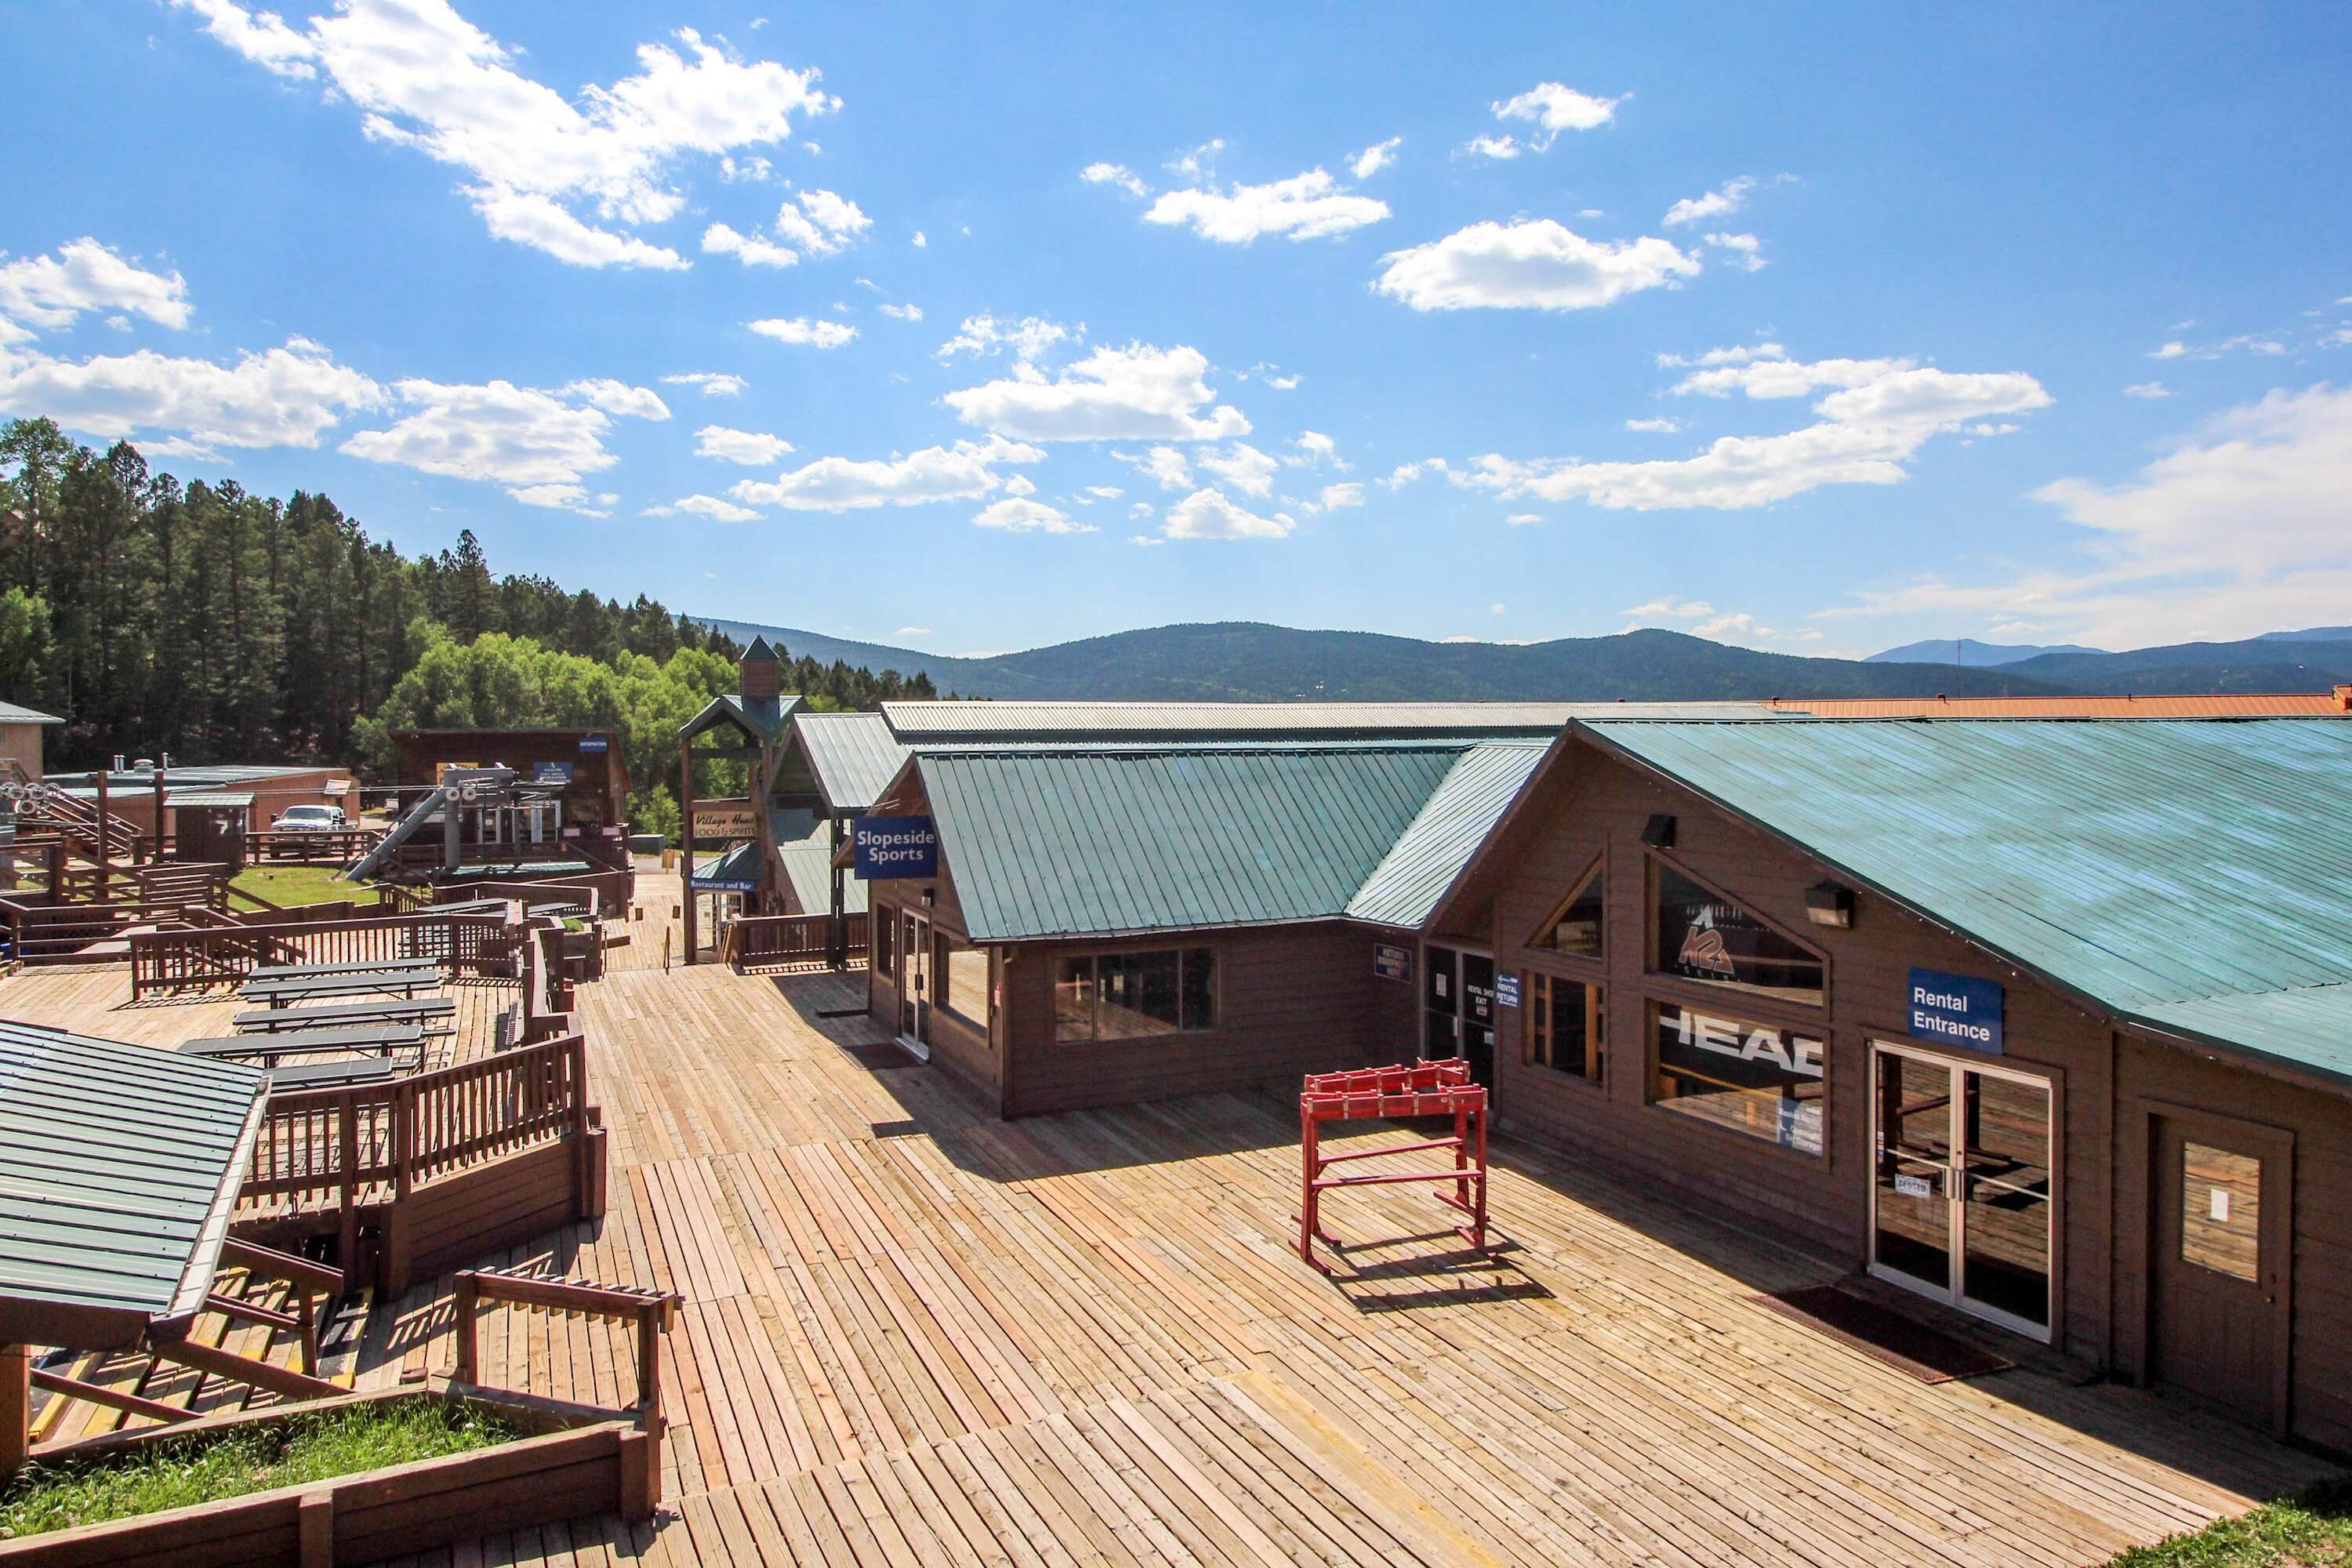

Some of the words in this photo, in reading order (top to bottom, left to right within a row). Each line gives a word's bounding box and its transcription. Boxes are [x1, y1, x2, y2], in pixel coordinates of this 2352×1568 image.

[695, 815, 728, 828] Village
[695, 827, 720, 837] FOOD
[857, 829, 935, 849] Slopeside
[869, 847, 924, 865] Sports
[690, 880, 724, 889] Restaurant
[1497, 982, 1518, 995] RENTAL
[1475, 996, 1487, 1005] EXIT
[1496, 991, 1518, 1004] RETURN
[1914, 986, 1968, 1012] Rental
[1914, 1010, 1991, 1041] Entrance
